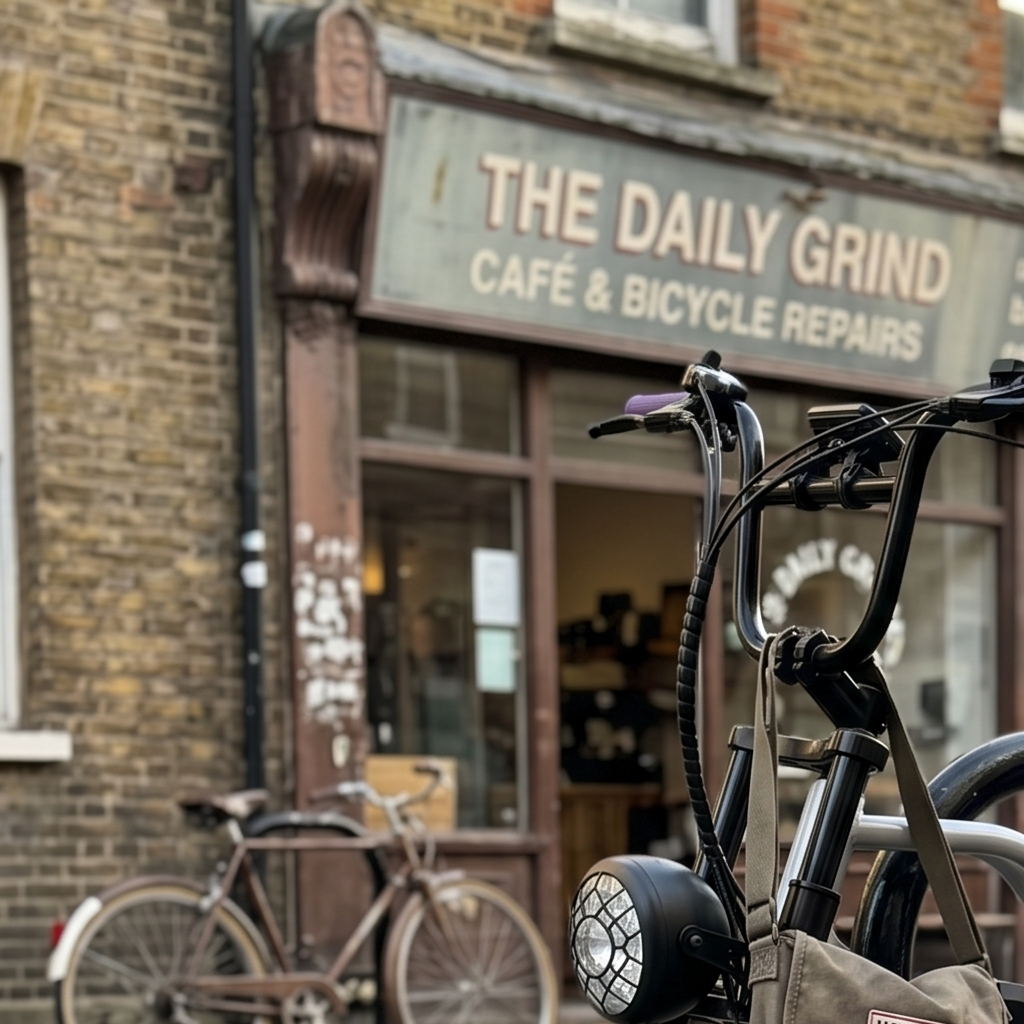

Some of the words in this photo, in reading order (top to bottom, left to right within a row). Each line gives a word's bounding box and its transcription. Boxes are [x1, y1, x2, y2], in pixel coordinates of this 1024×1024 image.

[479, 152, 604, 247] THE
[614, 179, 781, 276] DAILY
[788, 215, 951, 308] GRIND
[470, 249, 578, 307] CAFÉ
[584, 268, 612, 313] &
[621, 273, 777, 340] BICYCLE
[781, 301, 924, 362] REPAIRS
